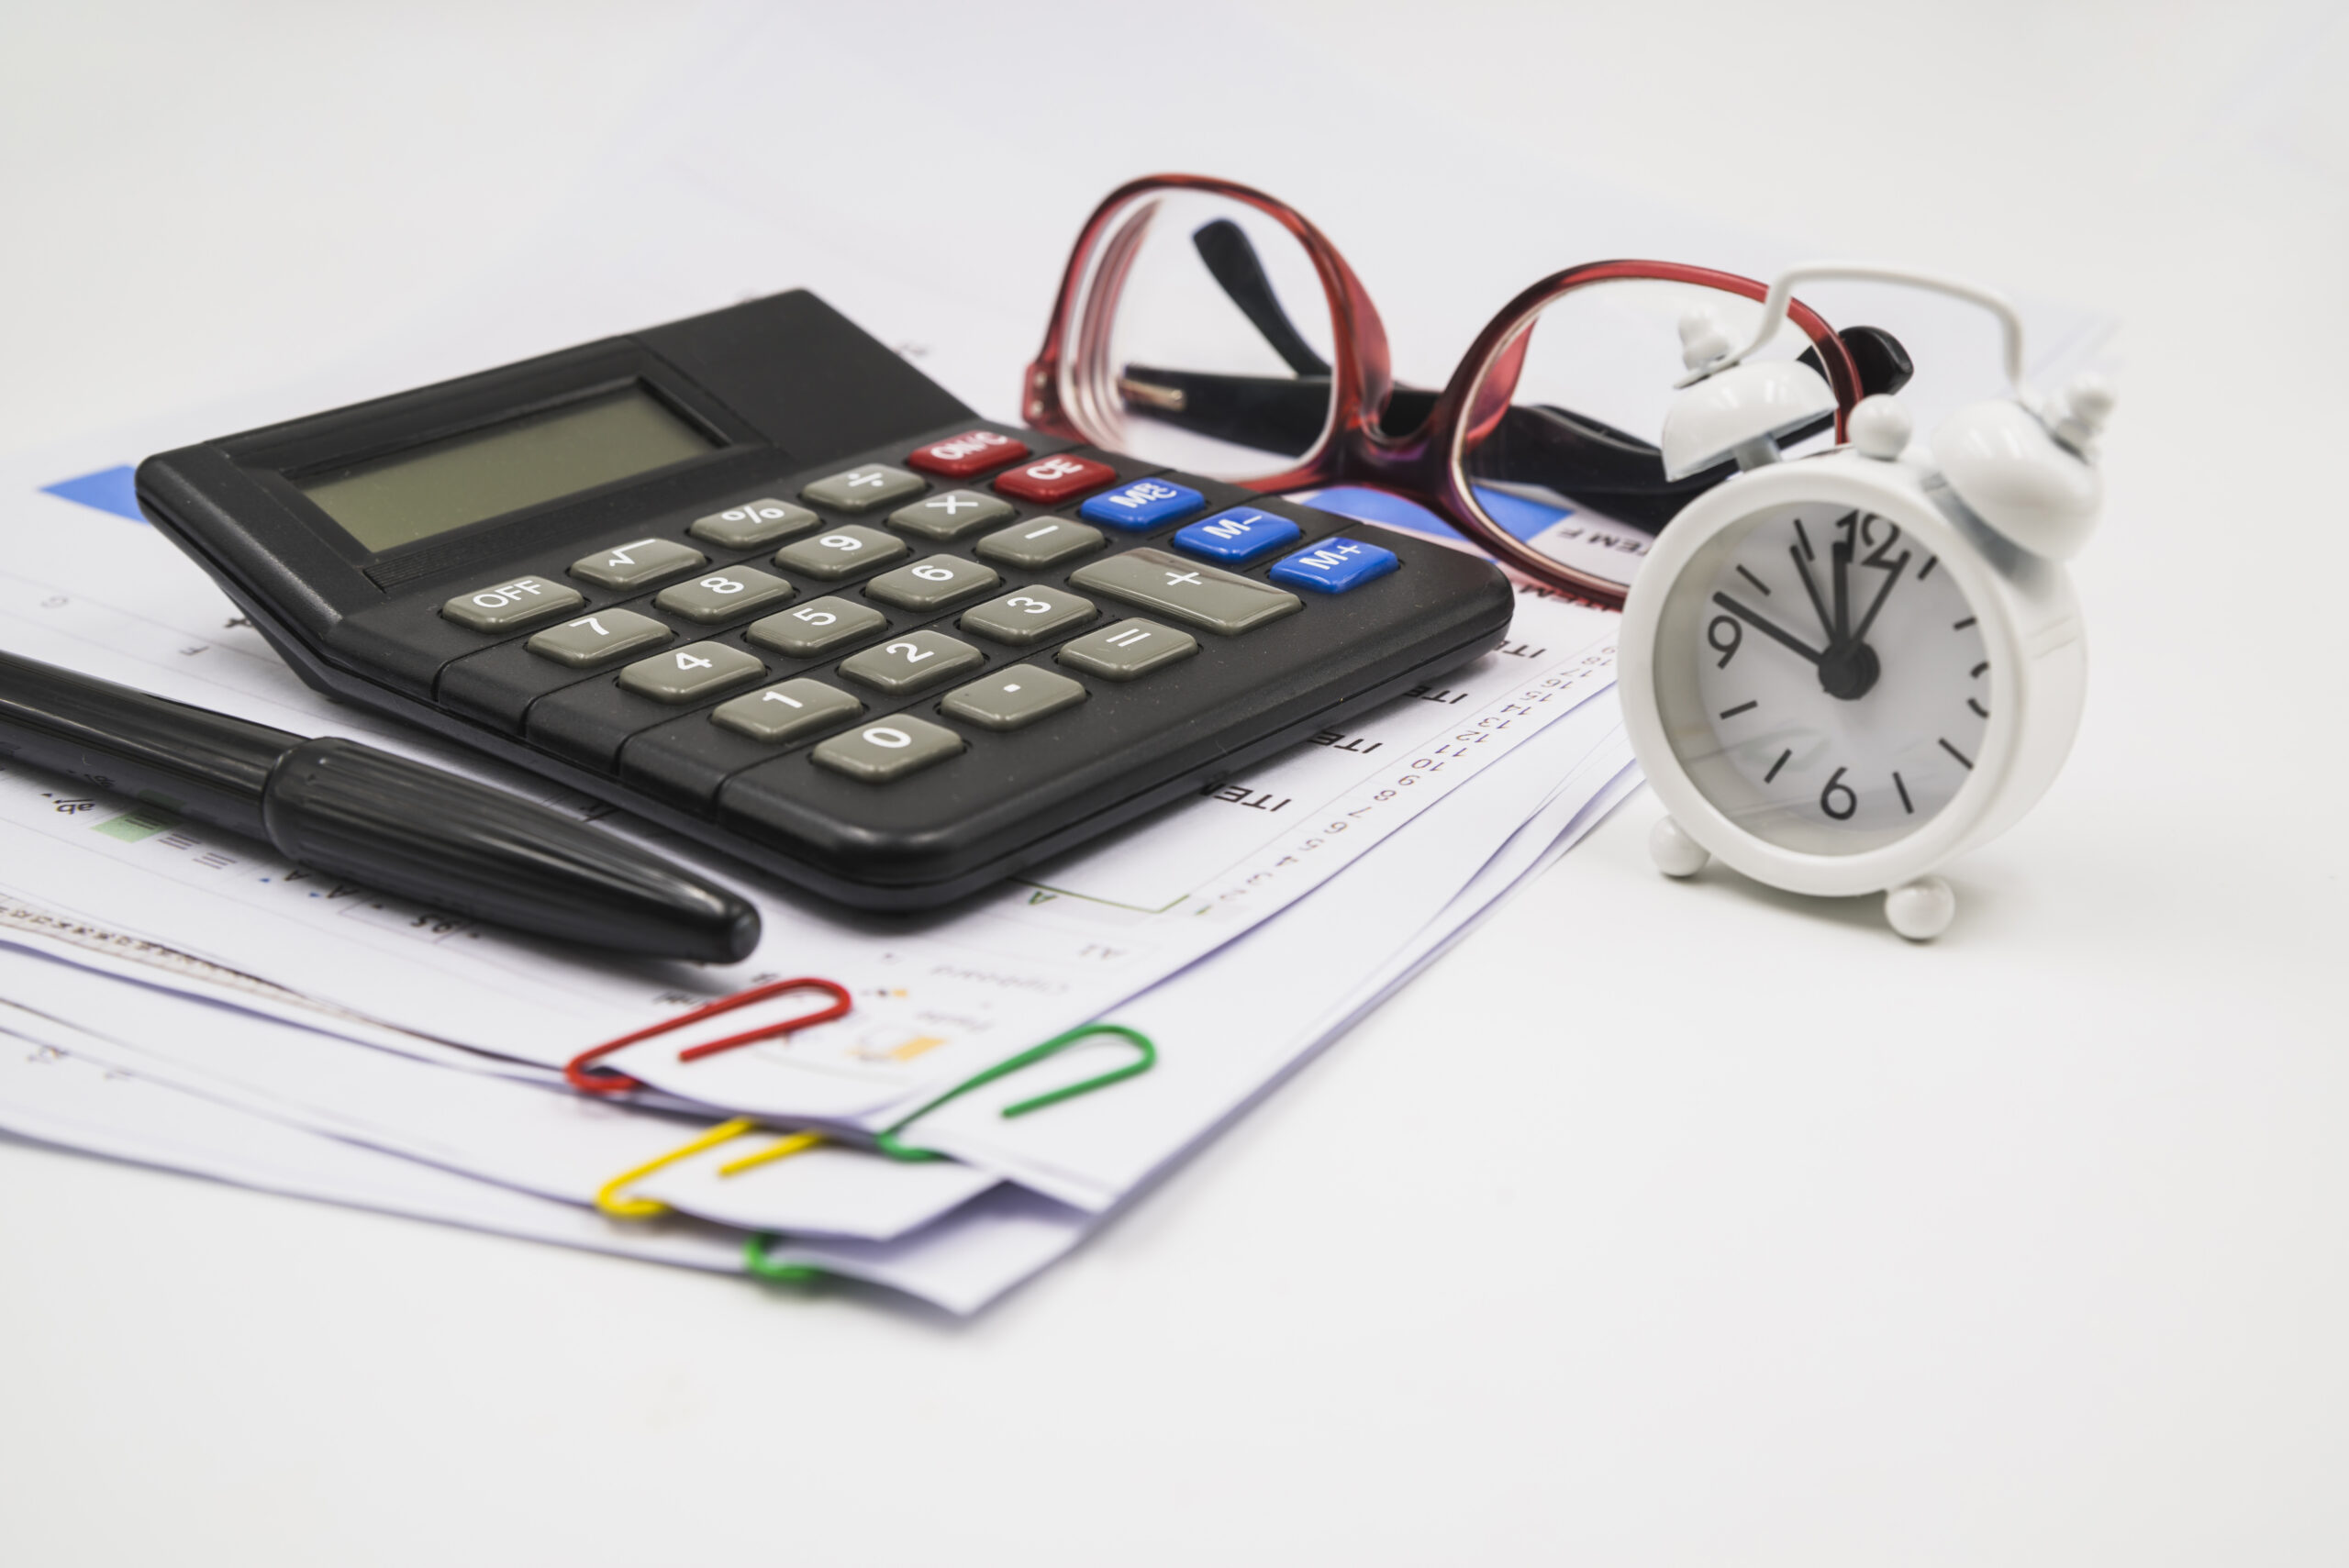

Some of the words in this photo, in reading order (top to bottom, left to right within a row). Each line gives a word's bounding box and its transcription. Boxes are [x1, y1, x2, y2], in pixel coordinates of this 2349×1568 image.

[1026, 458, 1083, 480] CE
[1556, 528, 1586, 539] F
[1835, 509, 1901, 570] 12
[819, 535, 863, 551] 9
[1587, 531, 1652, 556] TEM
[1298, 545, 1362, 571] M+
[911, 564, 954, 582] 6
[473, 579, 541, 608] OFF
[700, 576, 744, 595] 8
[1007, 596, 1052, 614] 3
[792, 607, 837, 626] 5
[569, 617, 610, 636] 7
[1707, 614, 1743, 670] 9
[675, 651, 713, 671] 4
[885, 642, 935, 663] 2
[1580, 656, 1613, 667] 18
[1560, 668, 1593, 678] 17
[1540, 678, 1574, 690] 16
[763, 691, 803, 708] 1
[1402, 686, 1469, 706] ITE
[1520, 690, 1553, 703] 15
[1500, 704, 1532, 716] 14
[1477, 717, 1511, 729] 13
[863, 727, 911, 749] 0
[1307, 730, 1384, 754] ITE
[1455, 729, 1490, 743] 12
[1434, 744, 1468, 758] 11
[1410, 758, 1445, 772] 10
[1397, 774, 1420, 786] 9
[1373, 789, 1397, 802] 8
[1820, 766, 1858, 821] 6
[1346, 806, 1373, 819] 7
[1324, 821, 1349, 835] 6
[1028, 891, 1059, 906] A
